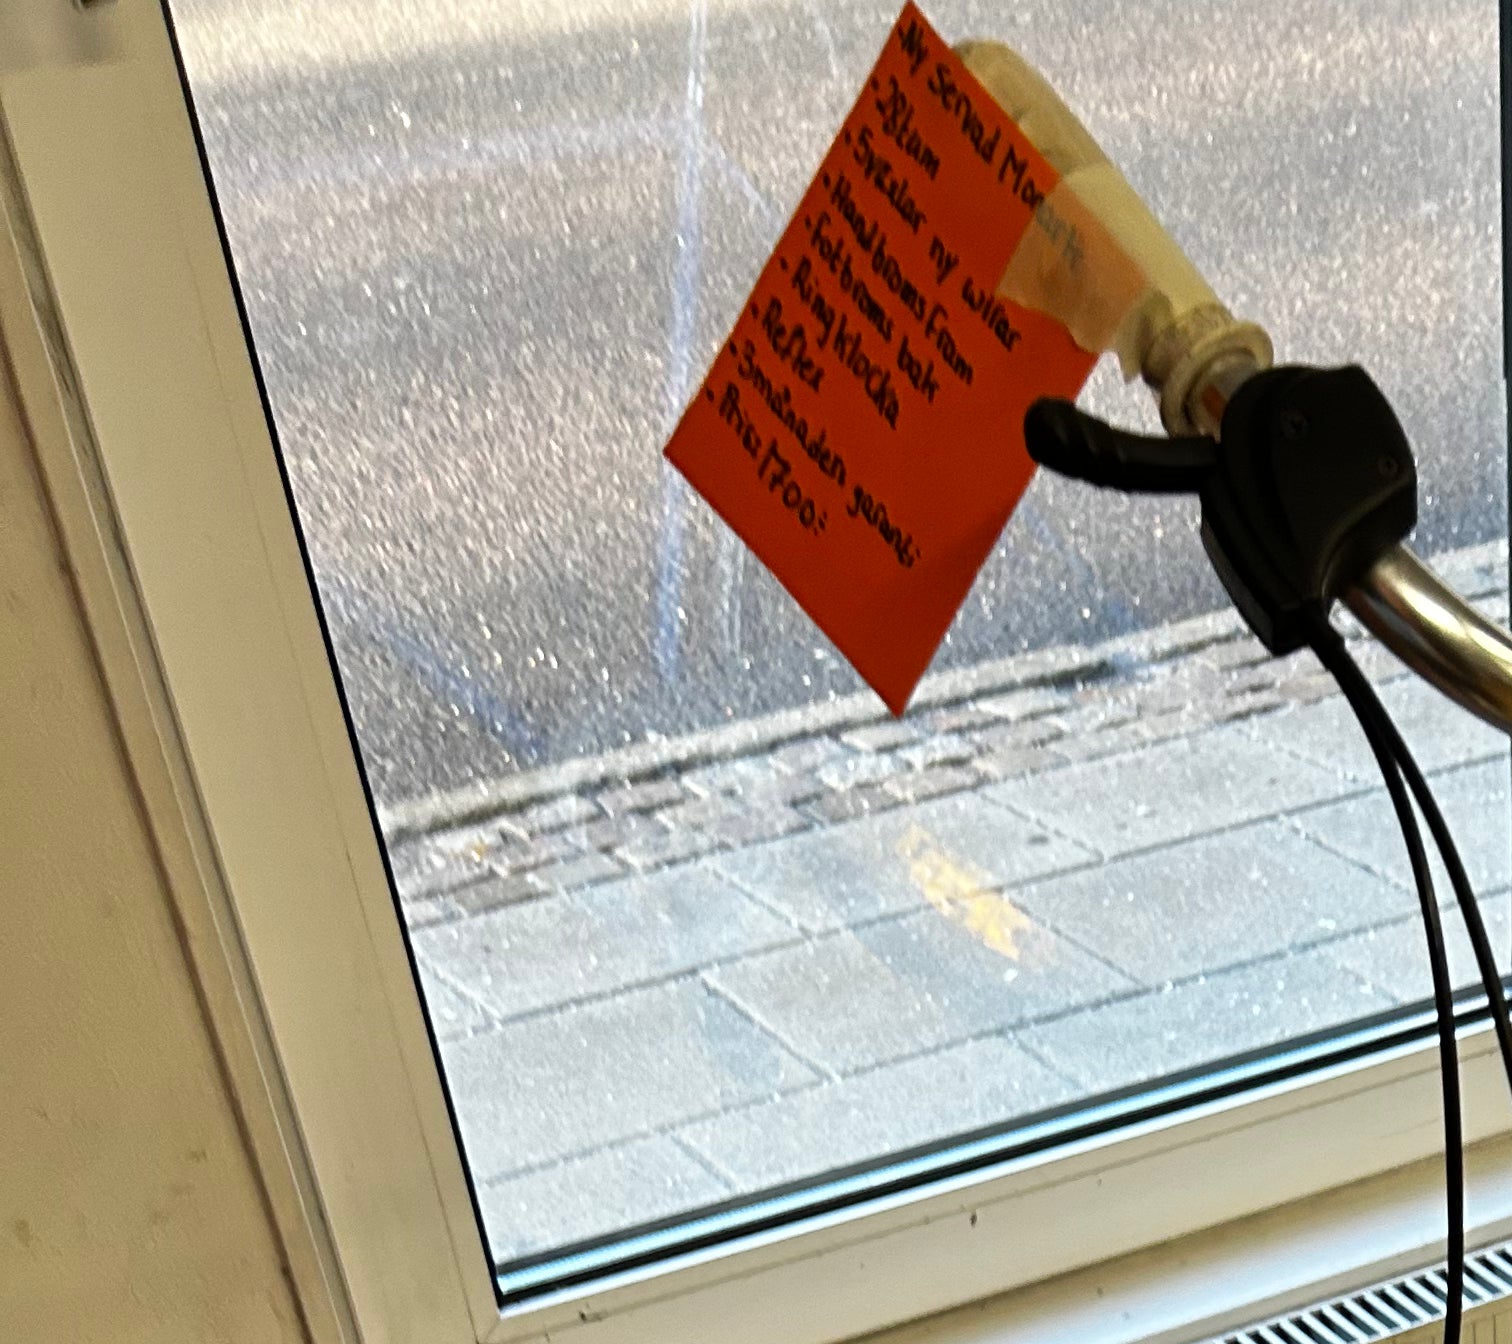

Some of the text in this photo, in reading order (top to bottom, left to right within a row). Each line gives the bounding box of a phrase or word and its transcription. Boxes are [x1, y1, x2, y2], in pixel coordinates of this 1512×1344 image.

[760, 296, 824, 392] Reflex
[896, 335, 939, 403] bak
[846, 484, 920, 568] garanti
